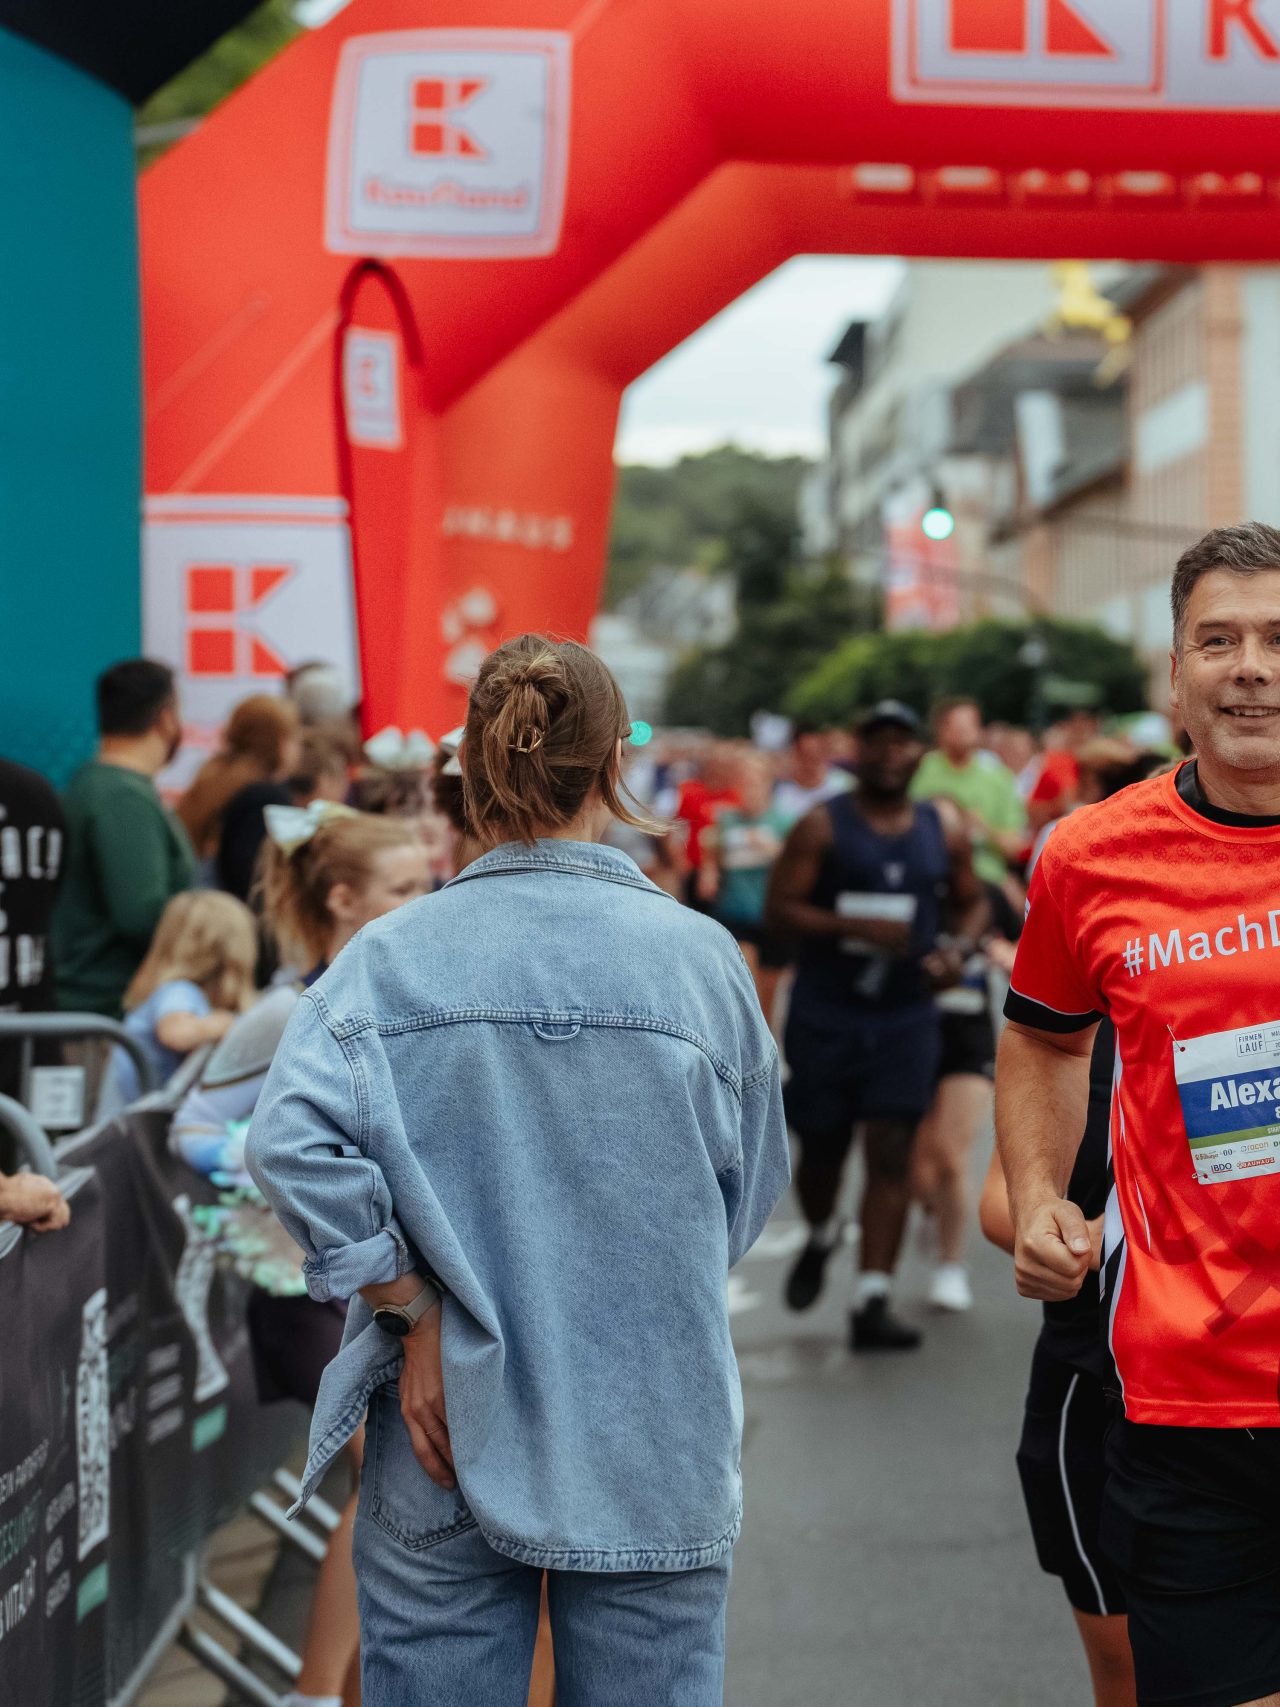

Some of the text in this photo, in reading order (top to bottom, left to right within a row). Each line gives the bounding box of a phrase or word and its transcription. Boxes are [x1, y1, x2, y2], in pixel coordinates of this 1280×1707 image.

[1238, 1033, 1263, 1043] FIRMEN
[1239, 1042, 1264, 1054] LAUF
[1214, 1162, 1232, 1172] BDO
